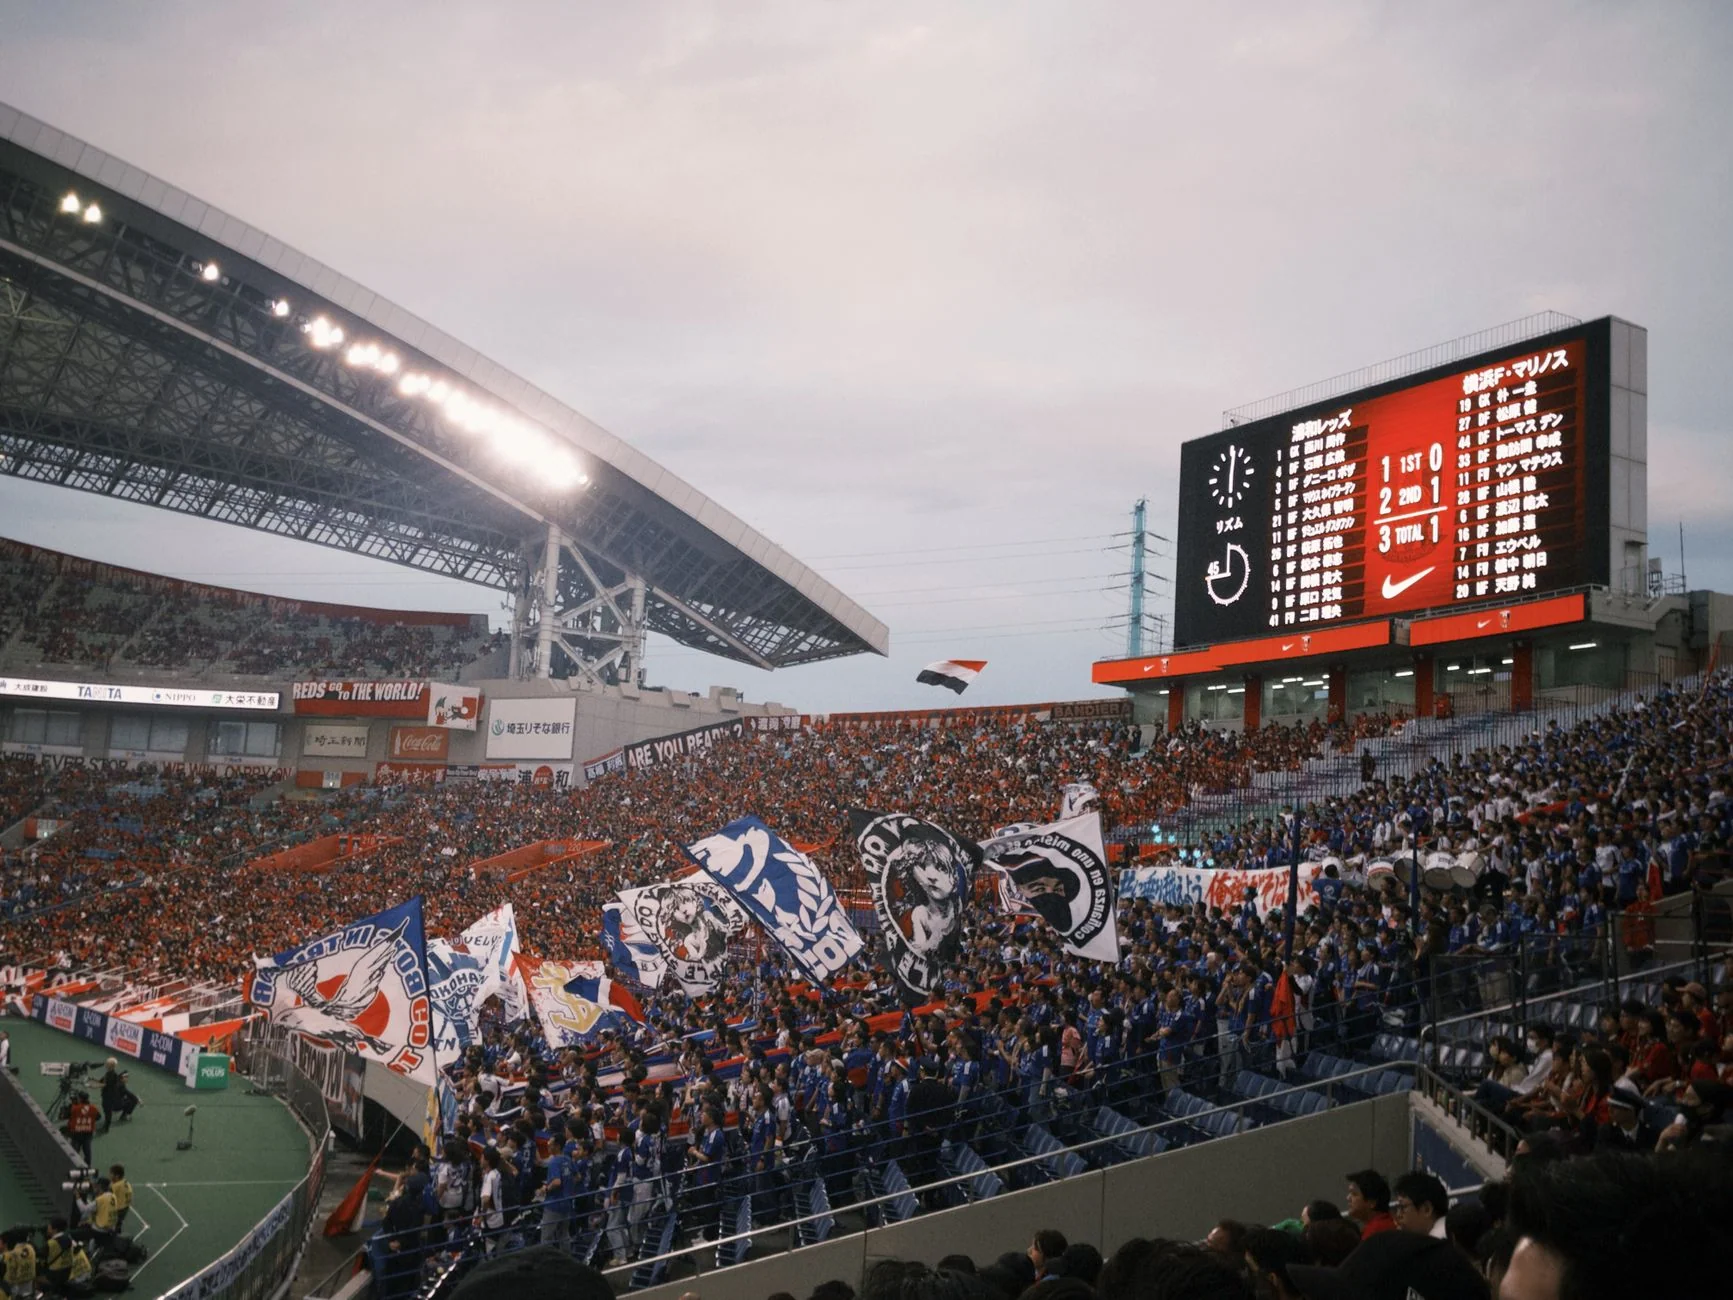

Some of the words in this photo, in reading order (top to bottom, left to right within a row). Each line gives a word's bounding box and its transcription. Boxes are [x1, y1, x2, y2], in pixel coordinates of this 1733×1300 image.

[1460, 398, 1471, 412] 19
[1292, 409, 1352, 442] 浦和レッズ
[1459, 416, 1471, 431] 27
[1458, 435, 1471, 449] 44
[1496, 419, 1537, 441] トーマス
[1540, 413, 1563, 430] デン
[1277, 450, 1281, 461] 1
[1382, 456, 1389, 482] 1
[1400, 452, 1422, 473] 1ST
[1429, 443, 1442, 471] 0
[1458, 453, 1470, 468] 33
[1276, 466, 1282, 478] 4
[1459, 472, 1469, 486] 11
[1496, 463, 1517, 478] ヤン
[1520, 451, 1563, 471] マテウス
[1275, 482, 1281, 494] 3
[1380, 487, 1392, 514] 2
[1399, 485, 1422, 506] 2ND
[1431, 476, 1439, 503] 1
[1275, 498, 1281, 511] 5
[1458, 490, 1470, 505] 28
[1272, 515, 1282, 528] 21
[1460, 509, 1467, 523] 6
[1216, 516, 1243, 534] リズム
[1272, 531, 1281, 544] 11
[1379, 525, 1391, 553] 3
[1395, 523, 1424, 544] TOTAL
[1430, 515, 1438, 543] 1
[1458, 528, 1470, 542] 16
[1271, 547, 1281, 561] 26
[1460, 547, 1466, 561] 7
[1495, 534, 1541, 554] エウベル
[1207, 560, 1220, 575] 45
[1273, 564, 1279, 577] 6
[1457, 565, 1469, 579] 14
[1271, 580, 1280, 592] 14
[1456, 584, 1469, 598] 20
[1272, 597, 1278, 610] 9
[1269, 614, 1279, 627] 41
[293, 682, 326, 700] REDS
[328, 683, 343, 692] GO
[351, 683, 374, 701] THE
[375, 682, 425, 701] WORLD!
[506, 722, 571, 735] 埼玉りそな銀行
[628, 743, 653, 768] ARE
[654, 737, 683, 762] YOU
[150, 1033, 173, 1053] AZ-COM
